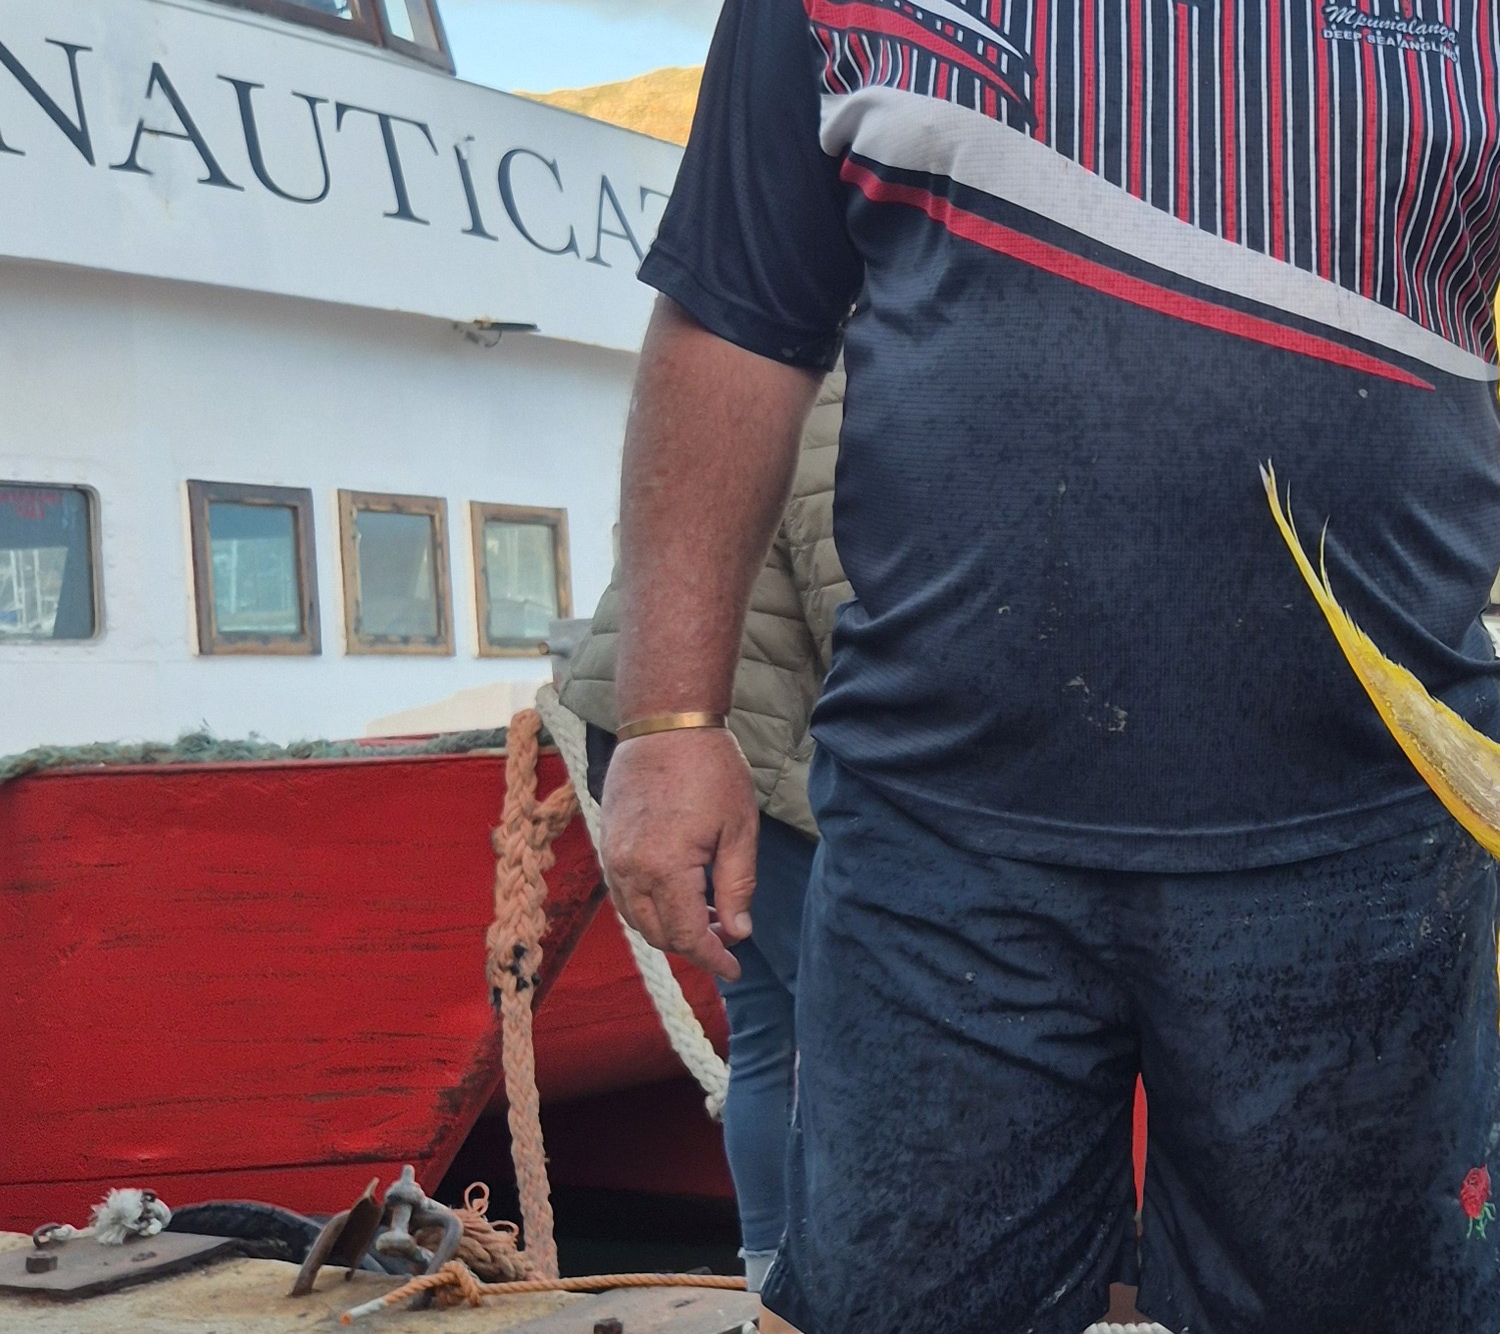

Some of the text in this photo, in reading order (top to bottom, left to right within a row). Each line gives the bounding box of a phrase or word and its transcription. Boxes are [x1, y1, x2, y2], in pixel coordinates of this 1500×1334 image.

[1324, 5, 1456, 44] Mpumalanga
[1323, 29, 1459, 64] DEEP SEA ANGLING
[0, 37, 671, 268] NAUTICA
